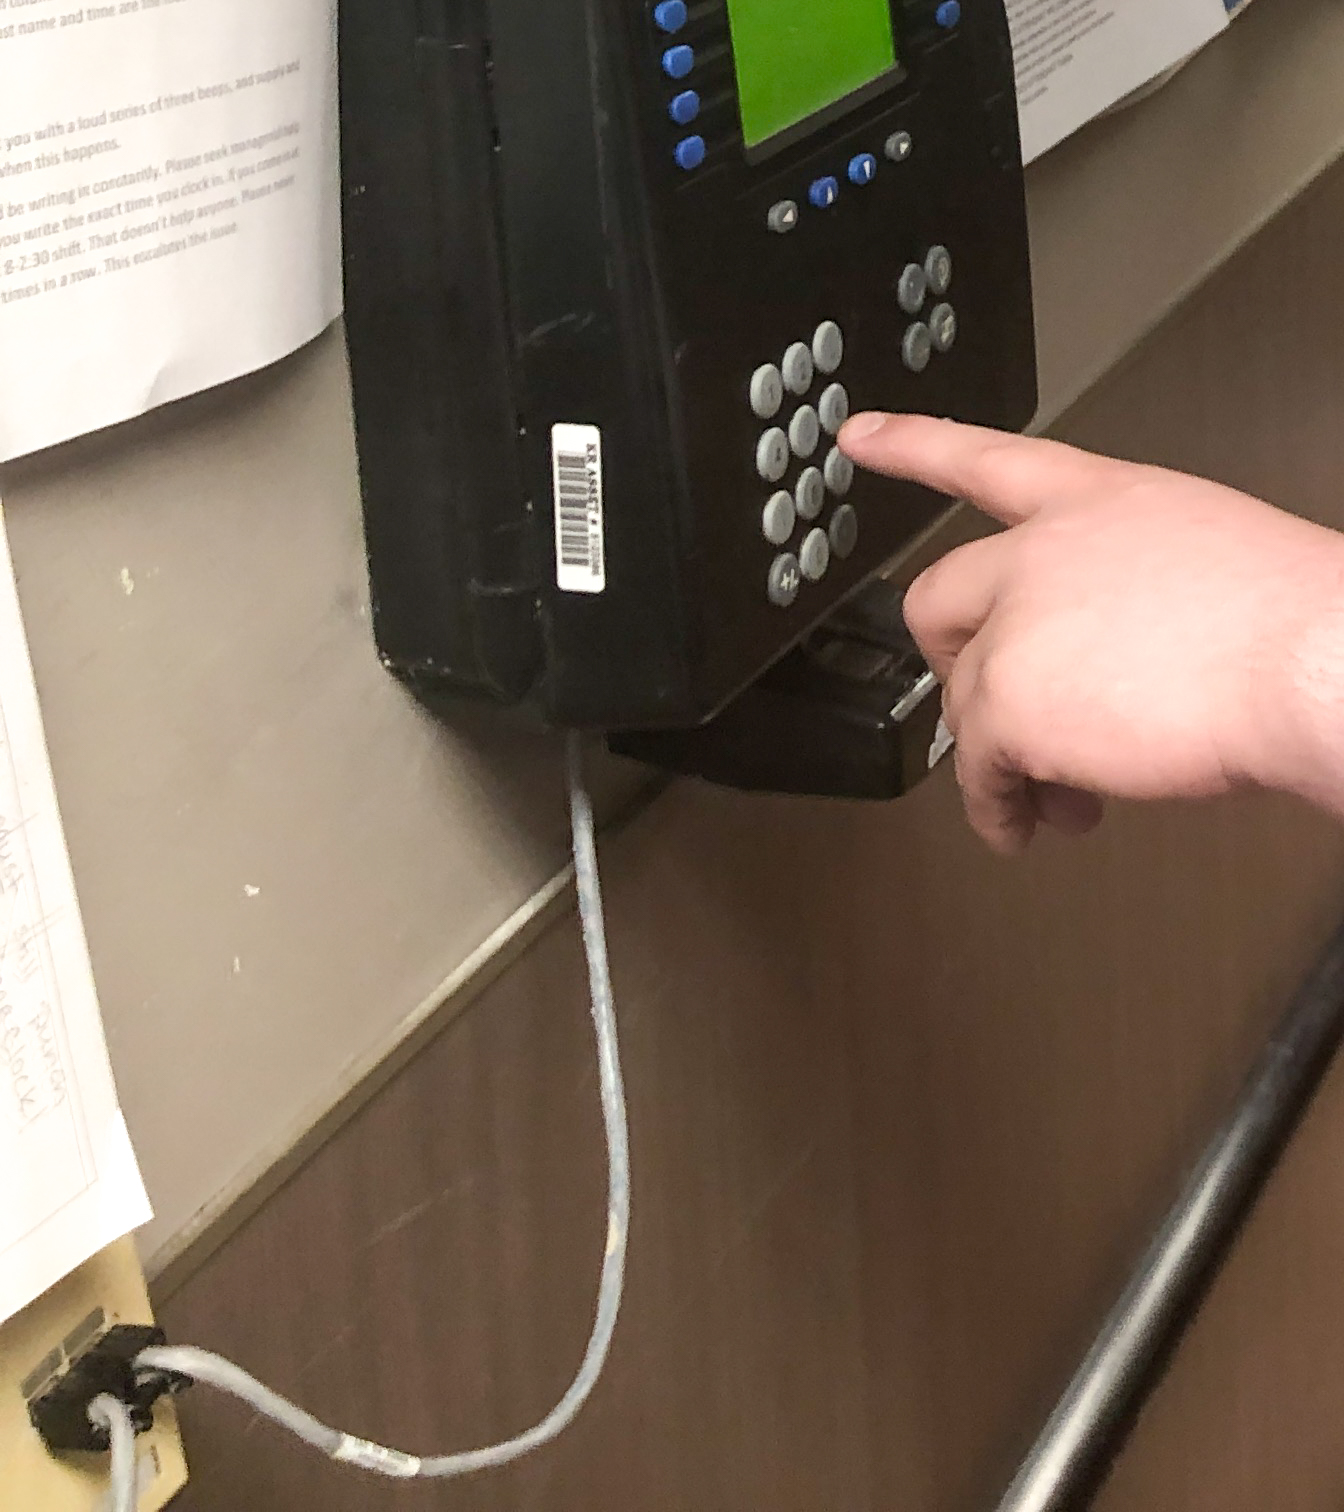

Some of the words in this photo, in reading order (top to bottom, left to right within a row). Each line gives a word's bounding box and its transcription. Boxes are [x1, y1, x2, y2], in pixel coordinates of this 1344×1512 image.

[18, 17, 56, 35] name
[60, 9, 83, 27] and
[87, 5, 115, 21] time
[119, 0, 138, 15] are
[35, 122, 64, 140] with
[78, 110, 106, 131] loud
[35, 152, 60, 170] this
[63, 214, 84, 230] the
[88, 231, 118, 251] That
